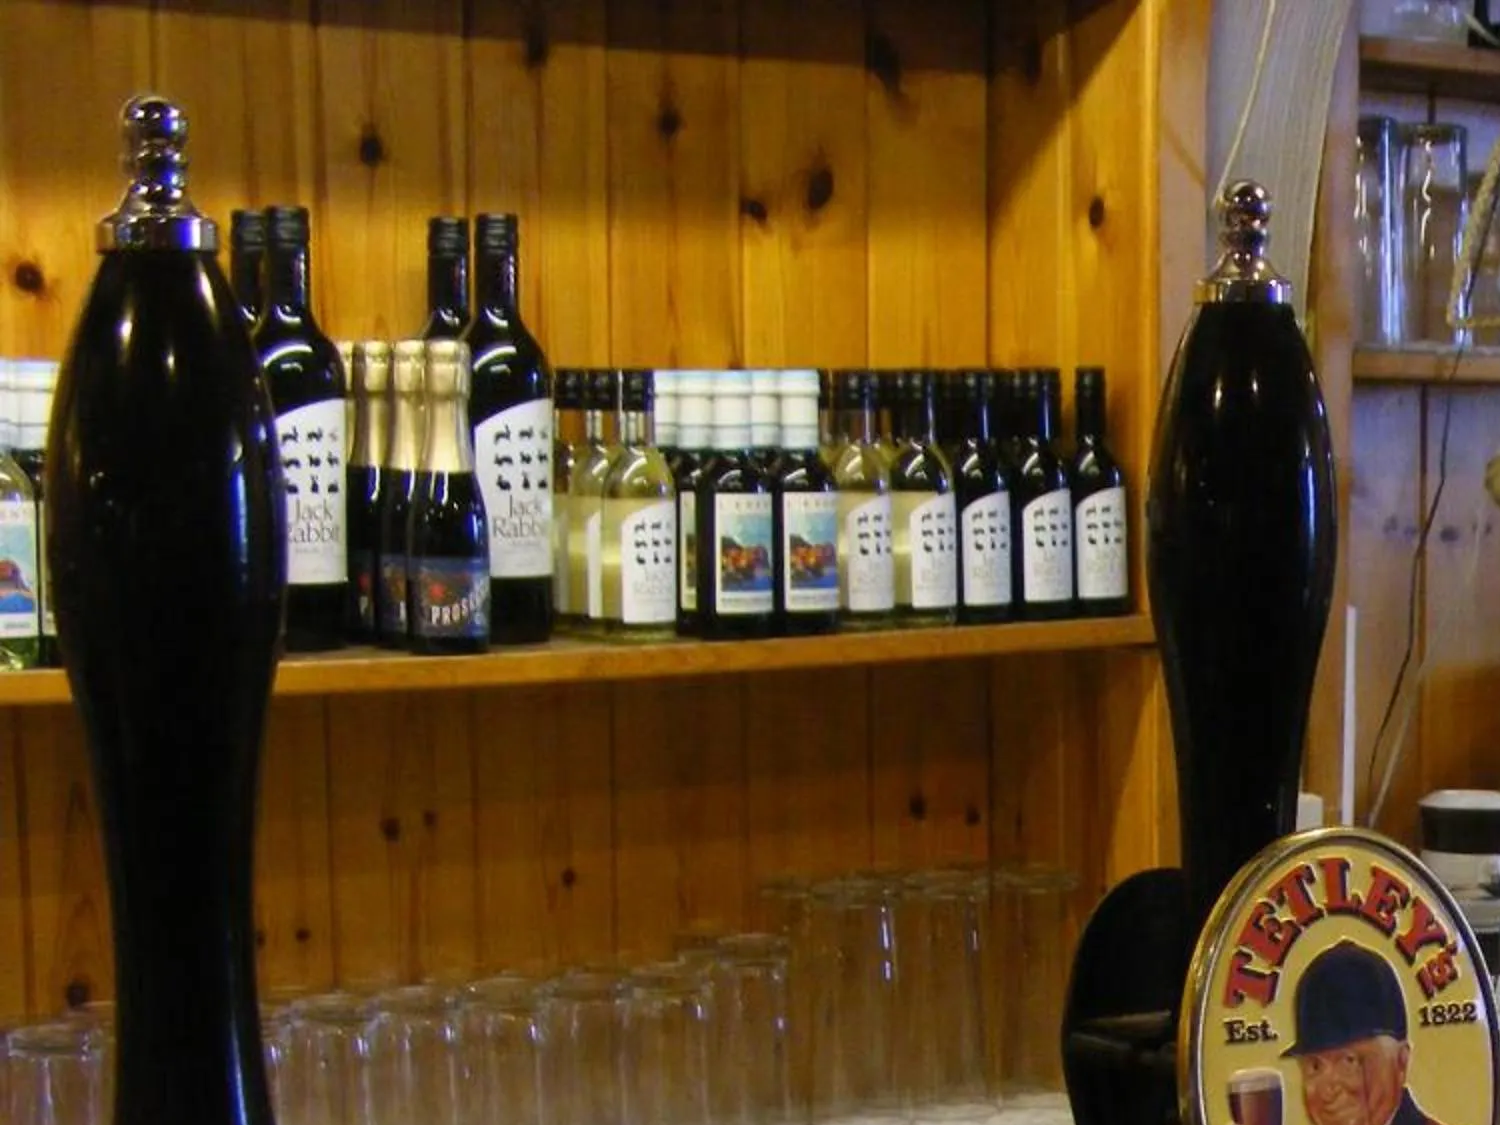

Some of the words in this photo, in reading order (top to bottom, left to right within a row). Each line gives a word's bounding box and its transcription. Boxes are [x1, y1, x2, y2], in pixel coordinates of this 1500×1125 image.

[1223, 857, 1459, 1008] TETLEY'S
[1223, 1018, 1279, 1044] Est.
[1418, 1002, 1478, 1027] 1822
